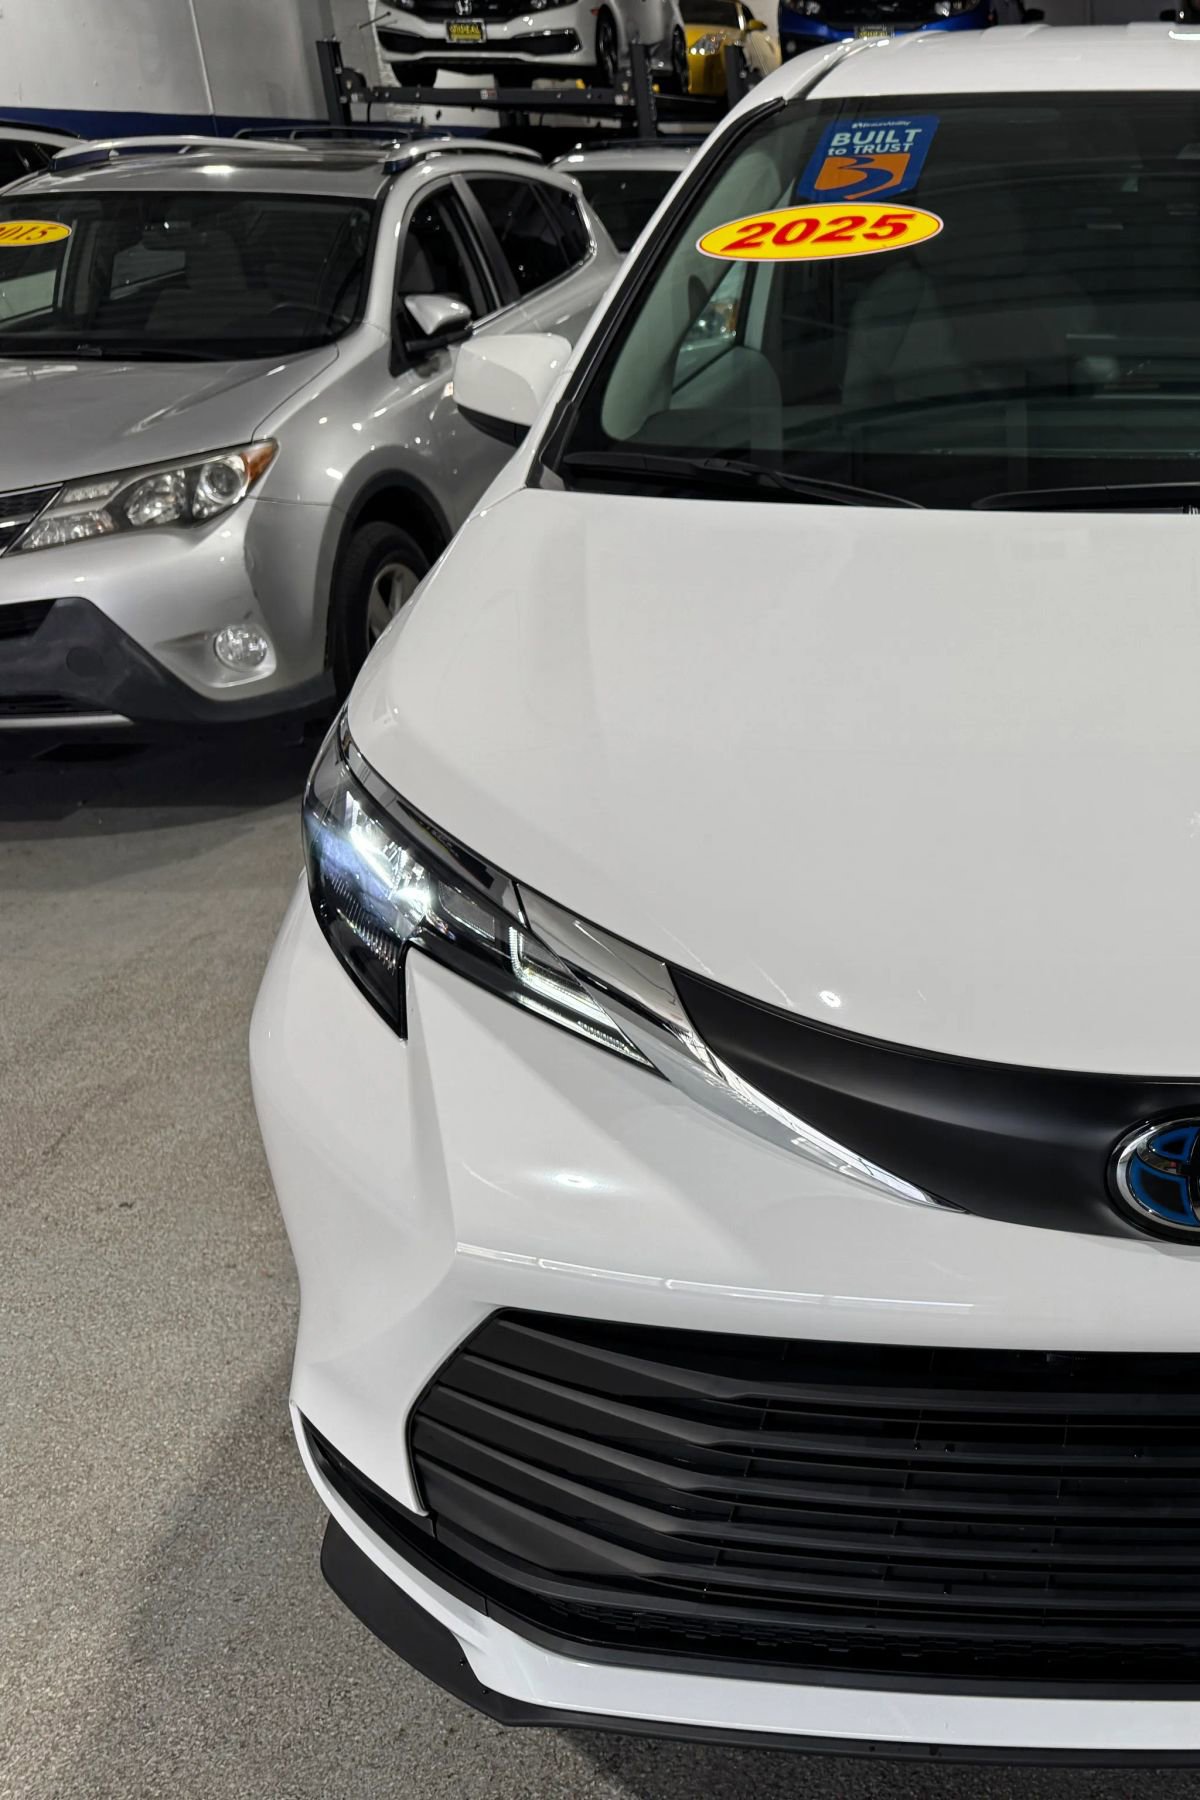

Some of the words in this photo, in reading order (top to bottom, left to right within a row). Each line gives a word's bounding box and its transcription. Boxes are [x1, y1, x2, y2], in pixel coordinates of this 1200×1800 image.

[830, 128, 922, 147] BUILT
[827, 147, 848, 156] to
[853, 142, 914, 154] TRUST
[719, 213, 917, 252] 2025
